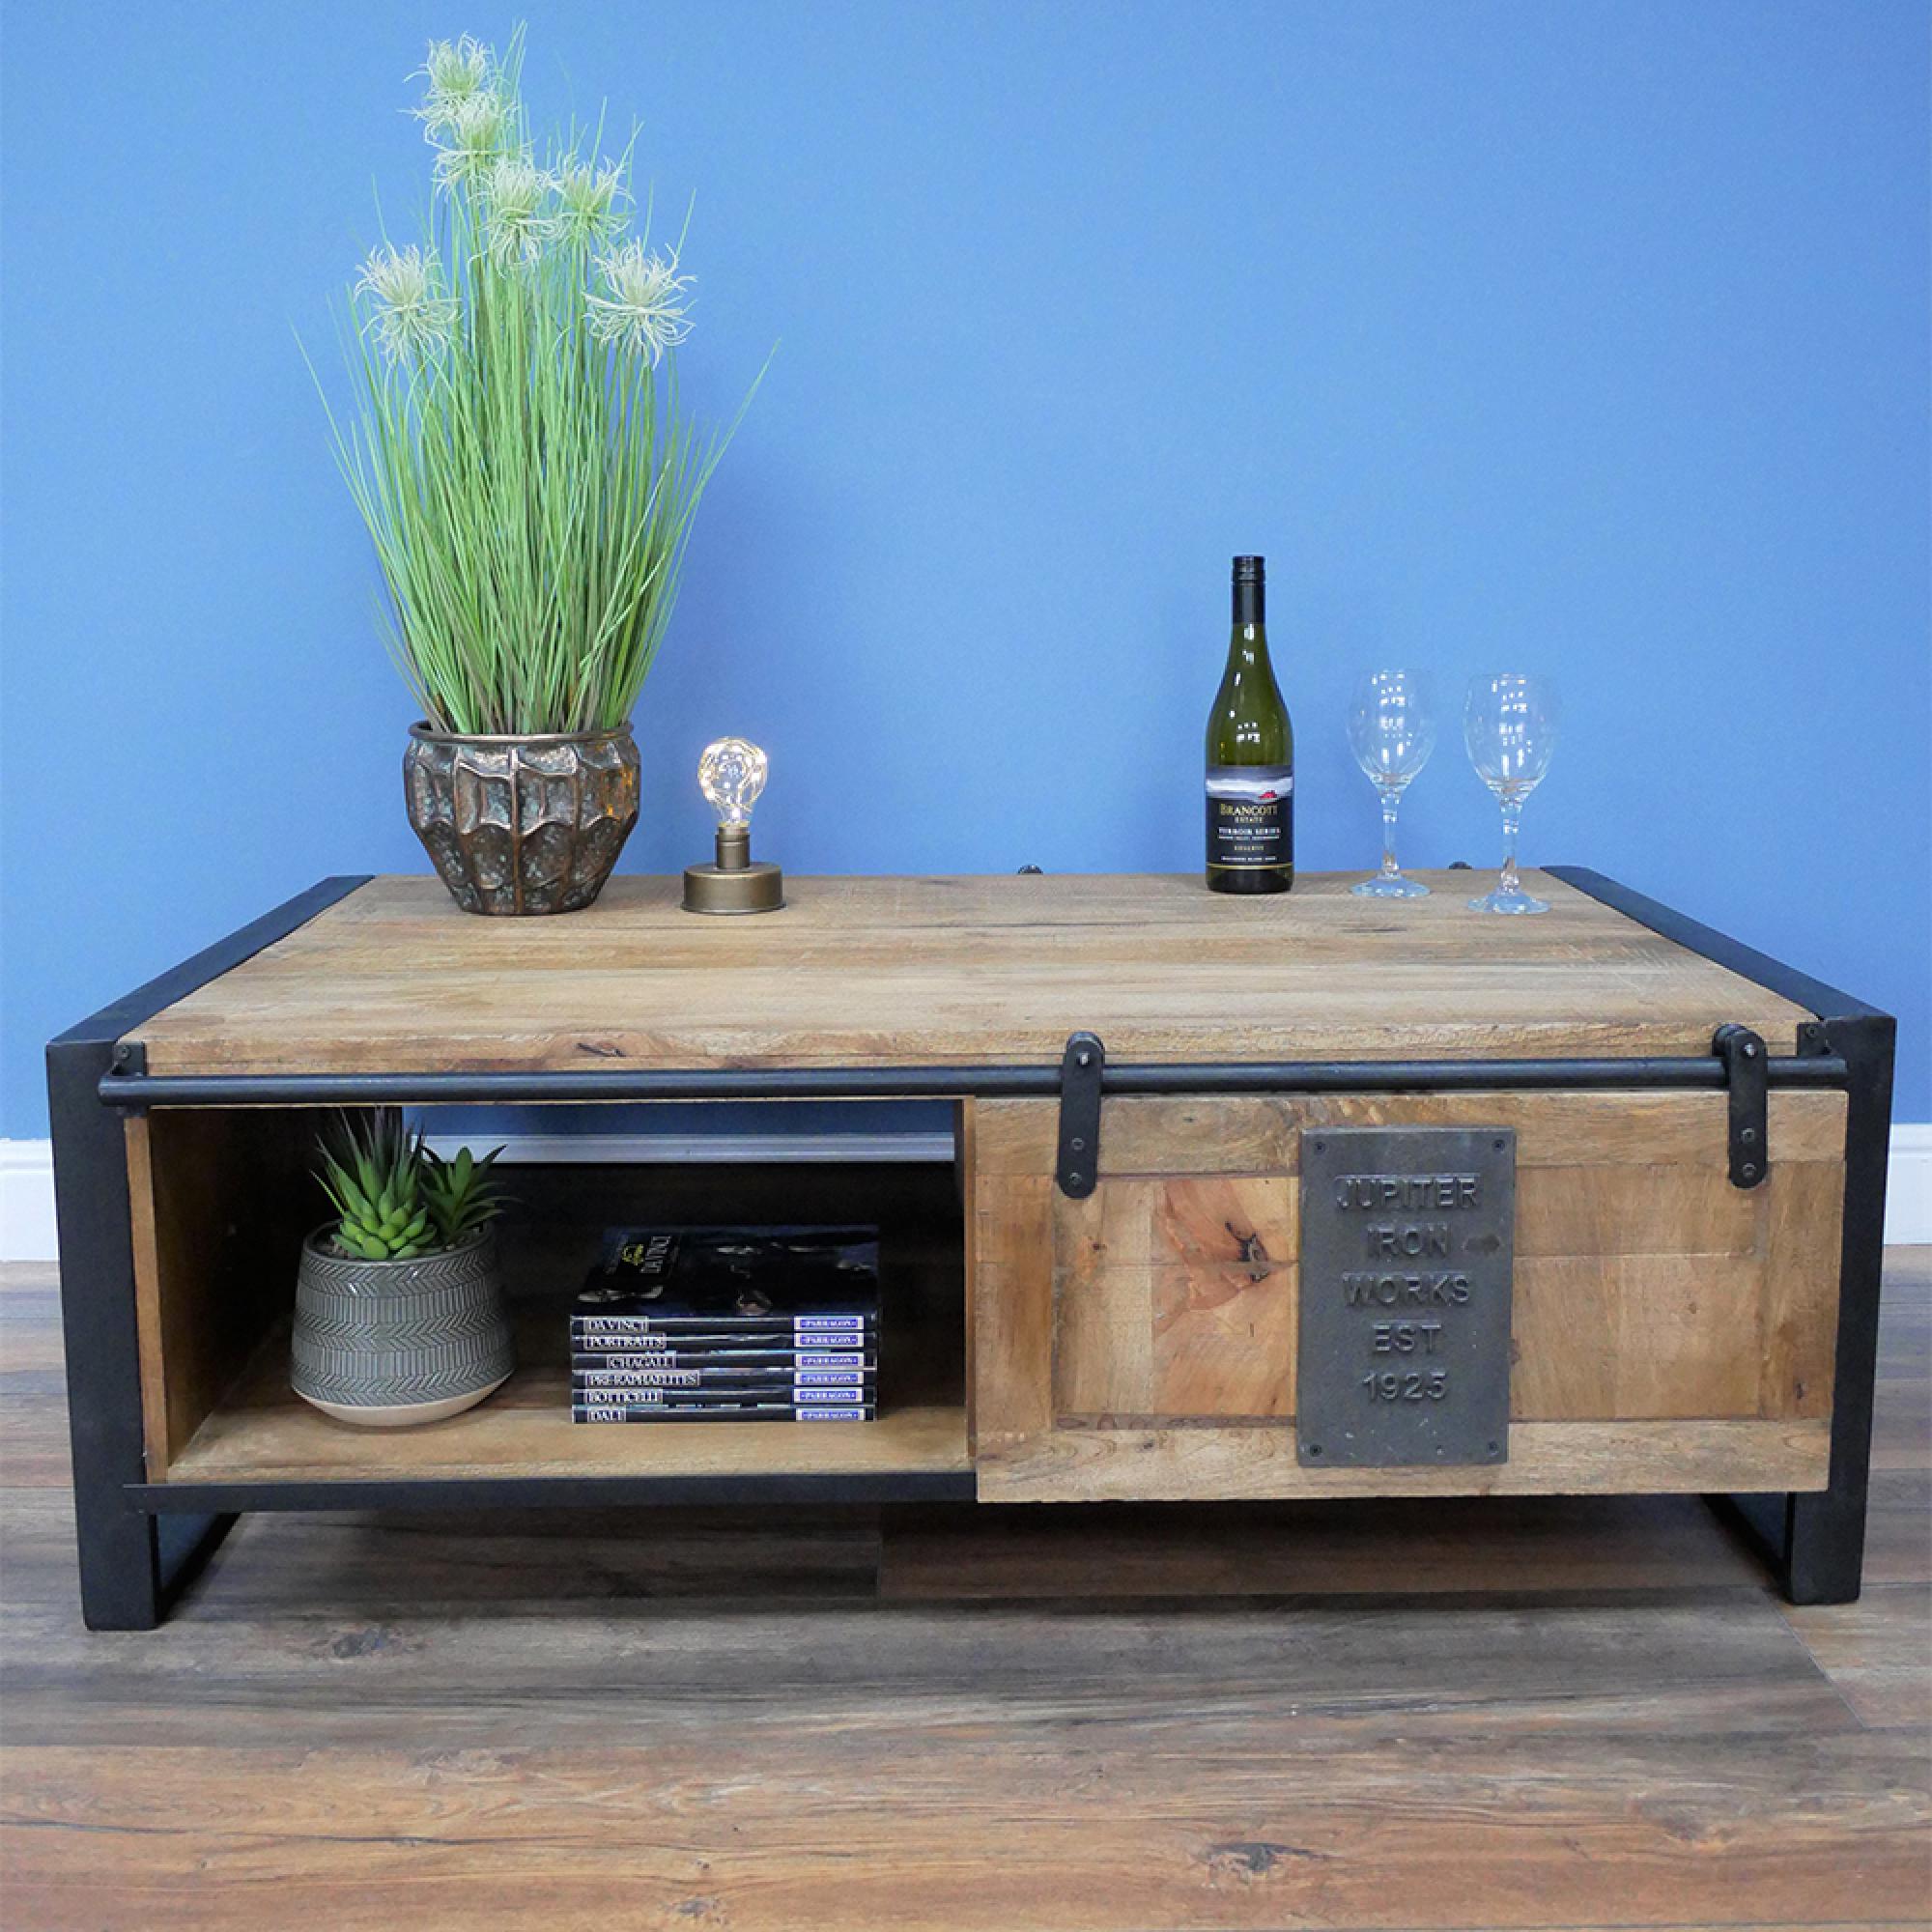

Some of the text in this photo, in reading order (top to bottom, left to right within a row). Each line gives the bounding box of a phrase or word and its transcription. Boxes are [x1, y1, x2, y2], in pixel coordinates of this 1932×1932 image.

[1336, 1175, 1479, 1208] JUPITER
[1368, 1223, 1447, 1256] IRON
[1343, 1272, 1469, 1305] WORKS
[1372, 1321, 1442, 1352] EST
[1361, 1371, 1447, 1401] 1925
